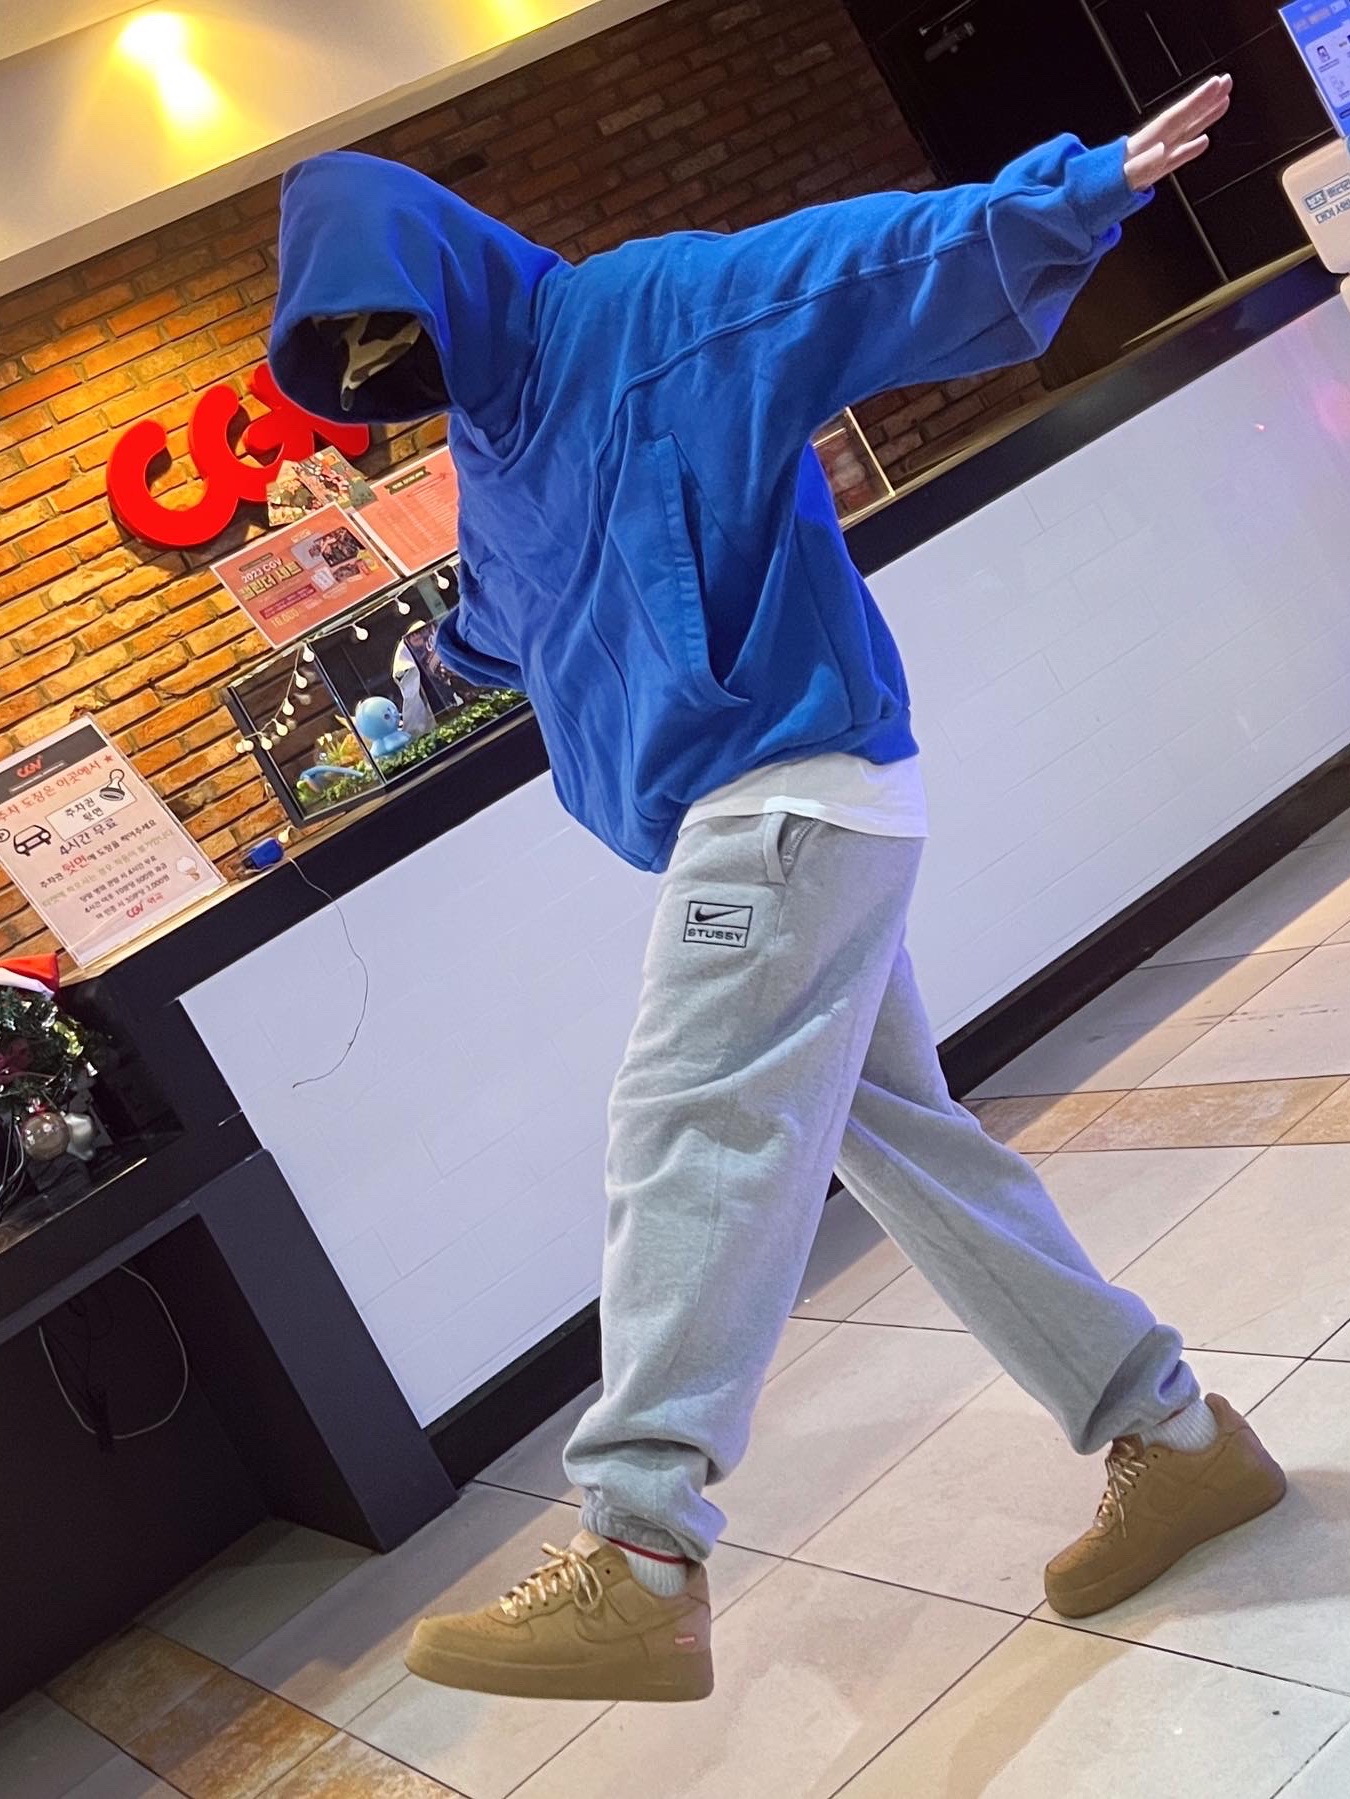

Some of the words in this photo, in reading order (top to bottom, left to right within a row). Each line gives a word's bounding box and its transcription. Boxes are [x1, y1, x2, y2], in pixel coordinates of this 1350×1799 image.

[242, 569, 264, 583] 2023
[263, 558, 282, 572] CGV
[17, 755, 43, 778] CGV
[22, 785, 57, 808] 도장은
[56, 760, 101, 787] 이곳에서
[65, 797, 96, 818] 주차권
[83, 807, 104, 822] 뒷면
[60, 832, 91, 855] 4시간
[93, 818, 118, 836] 무료
[126, 902, 144, 918] CGV
[687, 928, 743, 942] STUSSY
